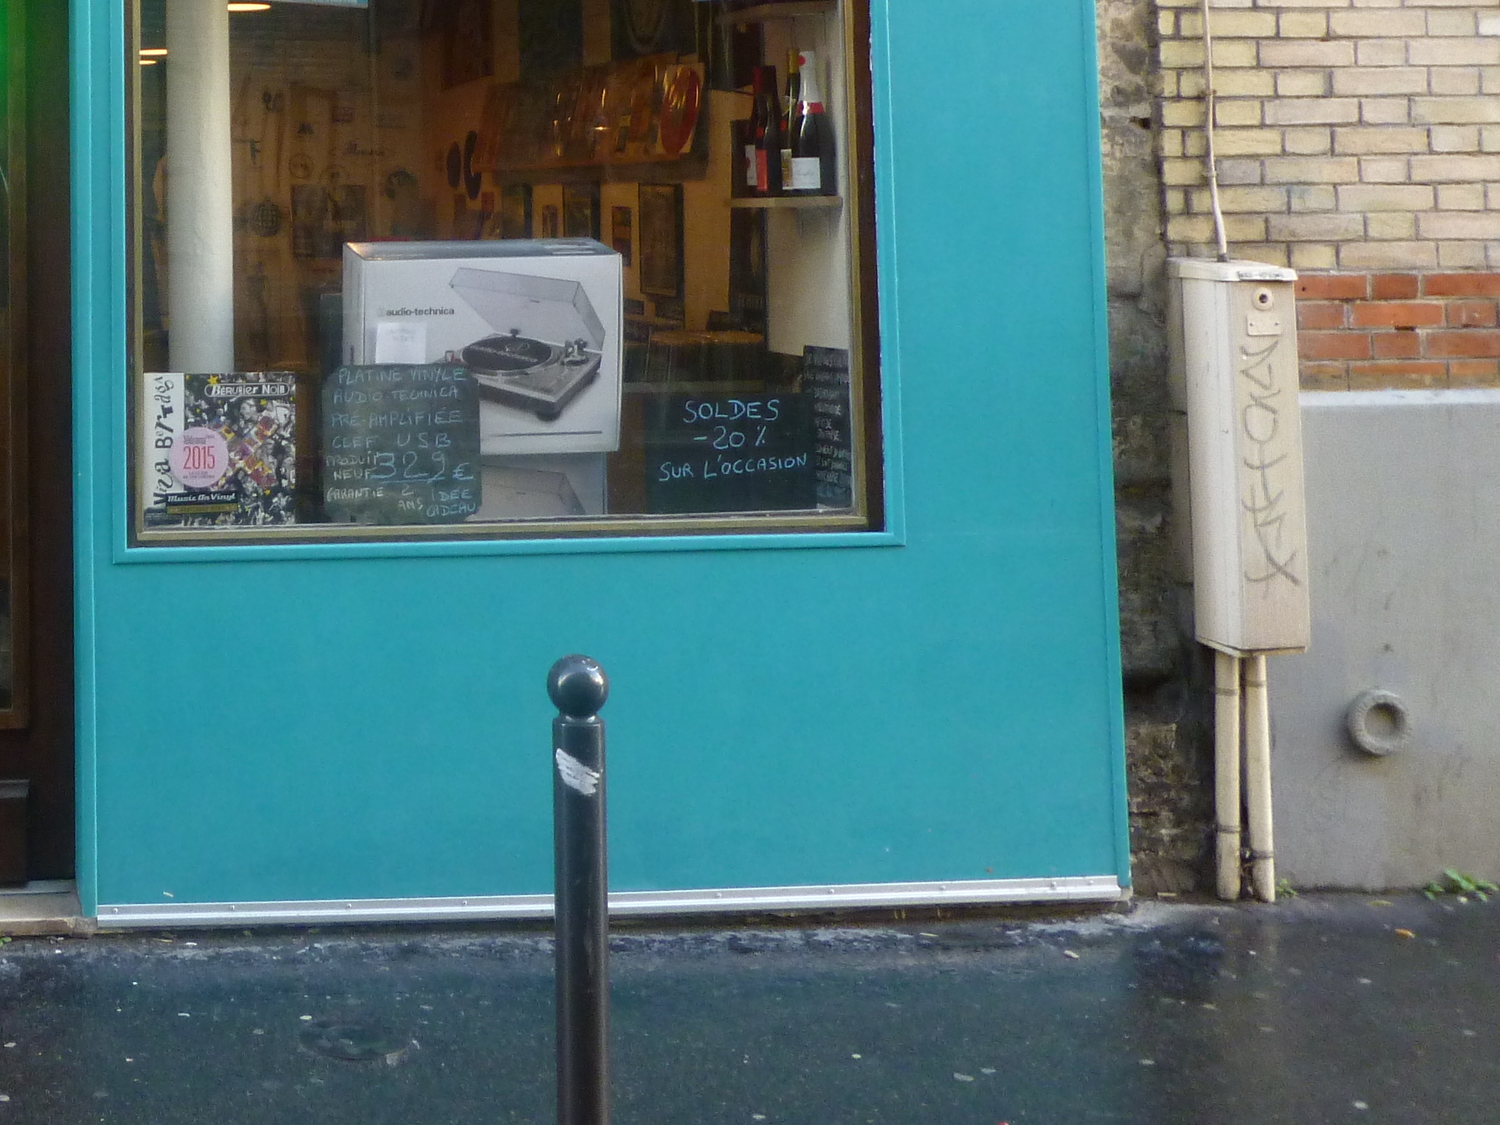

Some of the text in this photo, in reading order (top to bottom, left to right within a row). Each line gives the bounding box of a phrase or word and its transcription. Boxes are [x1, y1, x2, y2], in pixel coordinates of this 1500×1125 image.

[386, 306, 455, 317] audio-technica
[338, 366, 466, 385] PLATINE VINYLE
[683, 399, 780, 423] SOLDES
[332, 434, 378, 449] CLEF
[754, 425, 767, 446] %
[183, 446, 215, 470] 2015
[370, 451, 474, 480] 329 €
[334, 467, 376, 480] NEUF
[659, 462, 693, 481] SUR
[703, 453, 808, 479] L'OCCASION
[210, 493, 235, 501] Vinyl
[326, 486, 384, 502] GARANTIE
[398, 497, 423, 511] ANS
